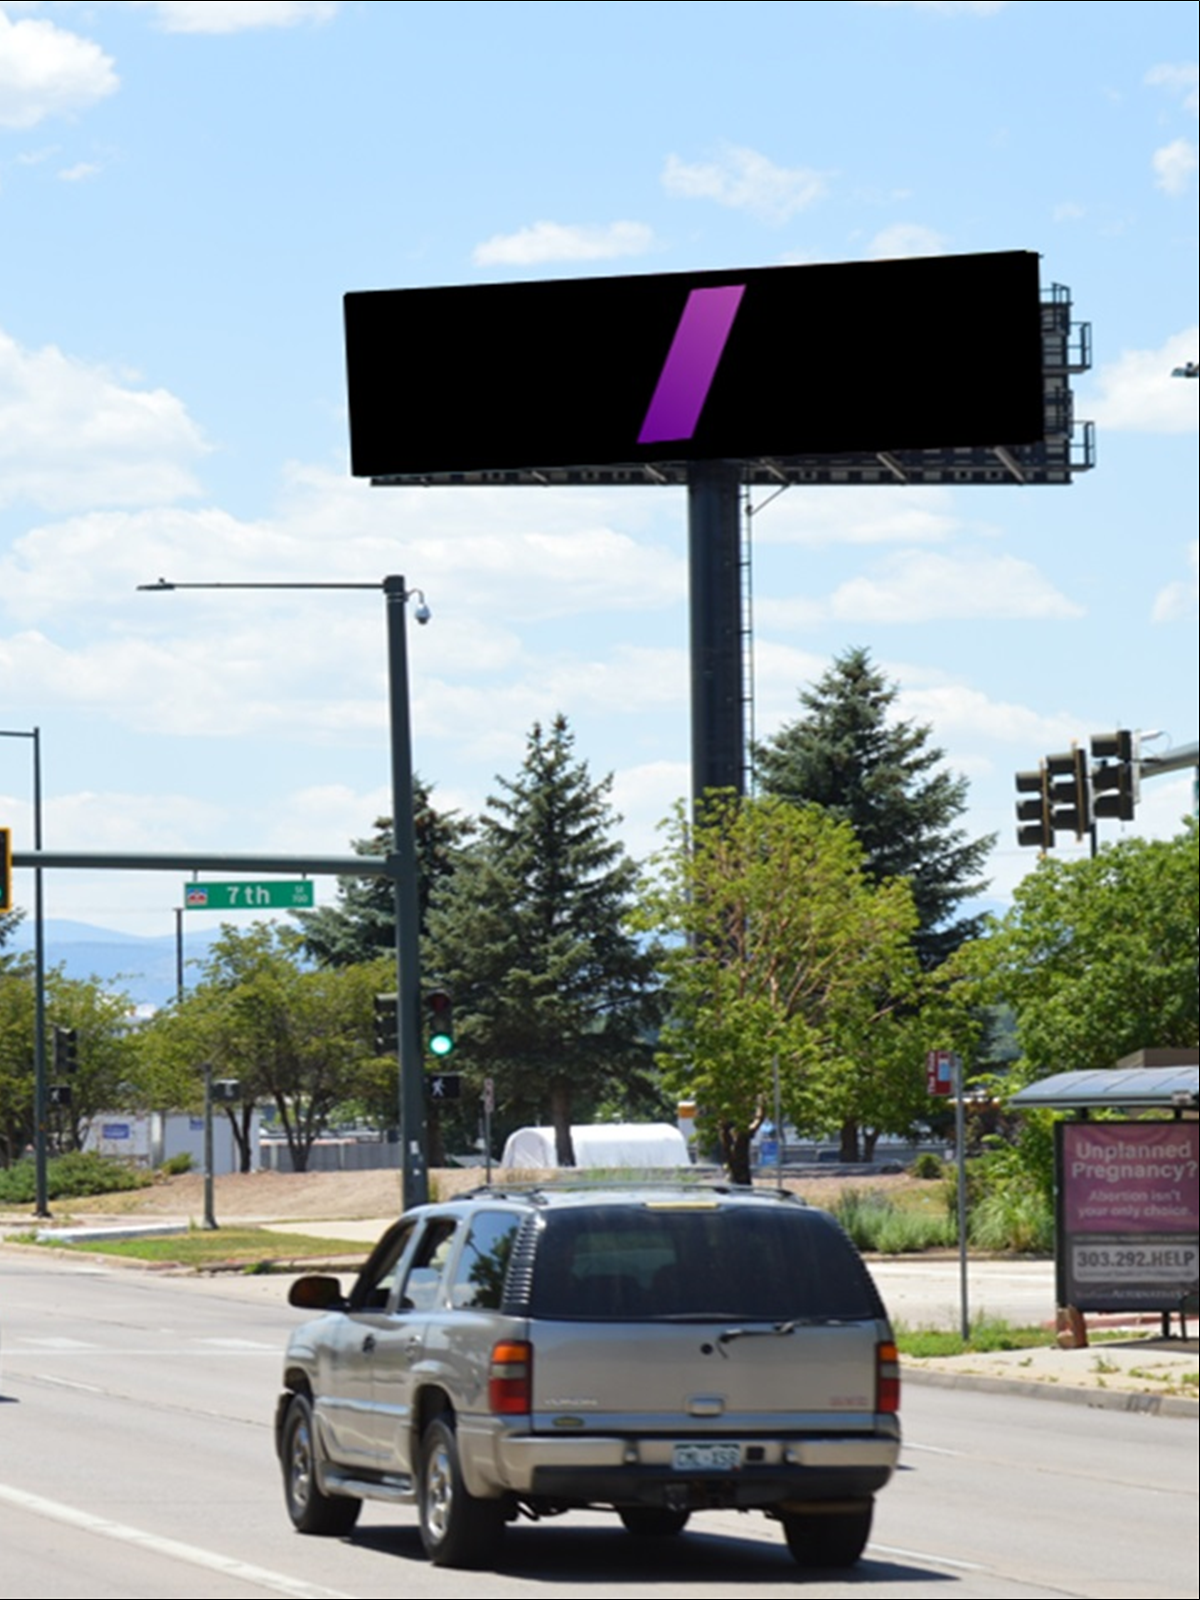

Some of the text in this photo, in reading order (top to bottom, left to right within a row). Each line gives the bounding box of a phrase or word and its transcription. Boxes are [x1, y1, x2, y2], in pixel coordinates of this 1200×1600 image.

[226, 885, 271, 905] 7th
[1075, 1140, 1192, 1163] Unplanned
[1072, 1160, 1198, 1182] Pregnancy?
[1089, 1188, 1182, 1202] Abortion isn't
[1078, 1207, 1109, 1219] your
[1110, 1204, 1140, 1218] only
[1076, 1250, 1196, 1268] 303.292.HELP
